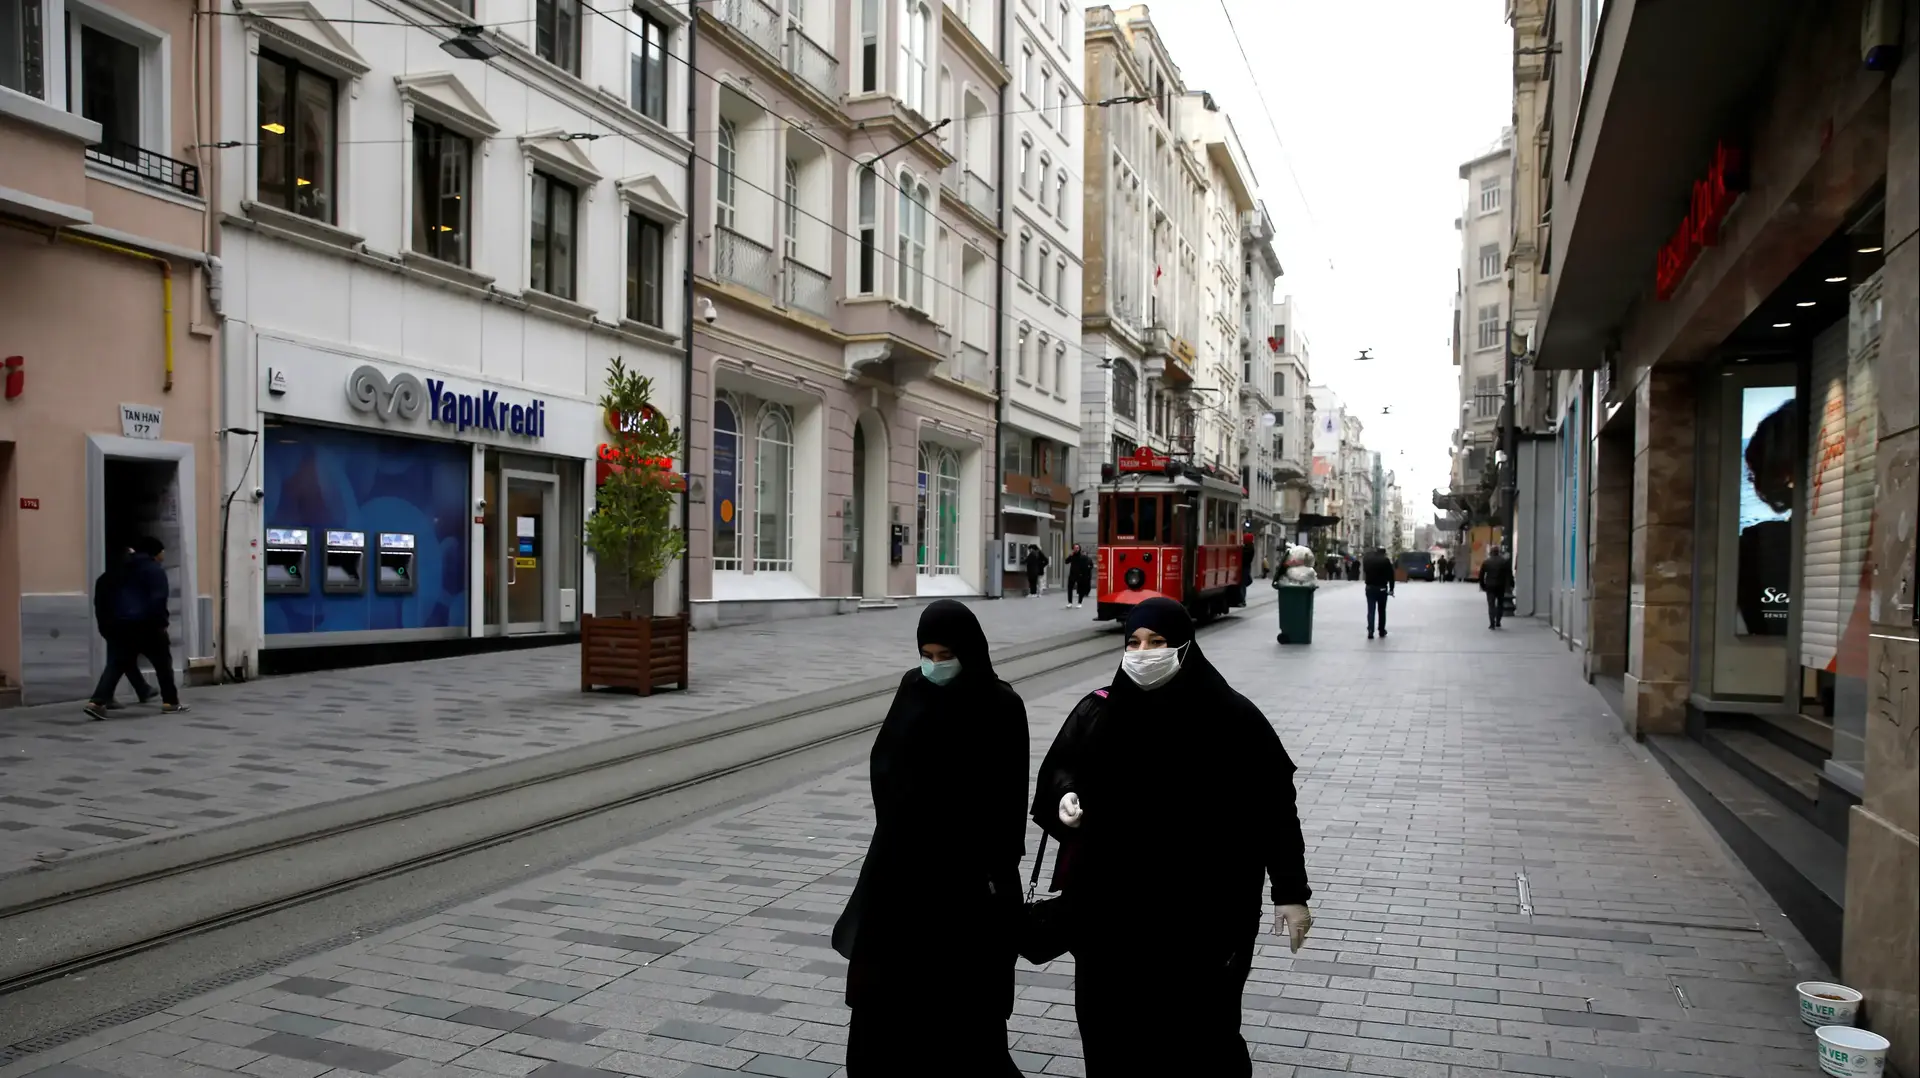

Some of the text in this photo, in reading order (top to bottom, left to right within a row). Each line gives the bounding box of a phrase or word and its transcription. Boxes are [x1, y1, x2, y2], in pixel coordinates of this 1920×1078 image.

[124, 409, 160, 424] TAN HAN
[134, 424, 150, 433] 177
[1141, 447, 1147, 457] 2
[1760, 586, 1791, 604] Se
[1815, 1004, 1835, 1017] VER
[1829, 1048, 1849, 1063] VER
